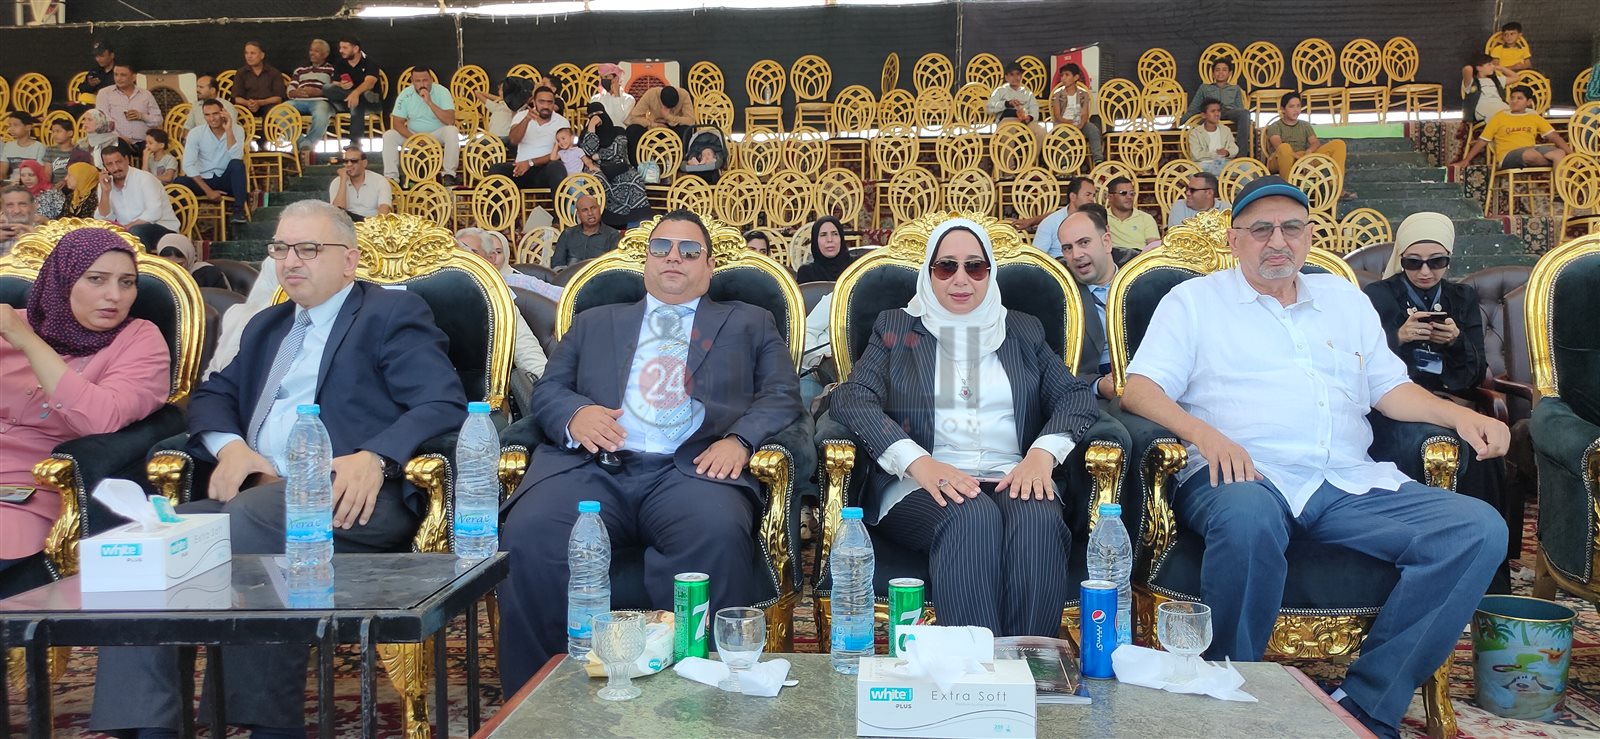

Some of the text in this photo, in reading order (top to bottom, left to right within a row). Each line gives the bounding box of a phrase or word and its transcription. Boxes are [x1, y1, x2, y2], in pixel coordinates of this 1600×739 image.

[102, 544, 137, 556] white
[871, 687, 907, 701] white
[931, 690, 1007, 702] Extra Soft
